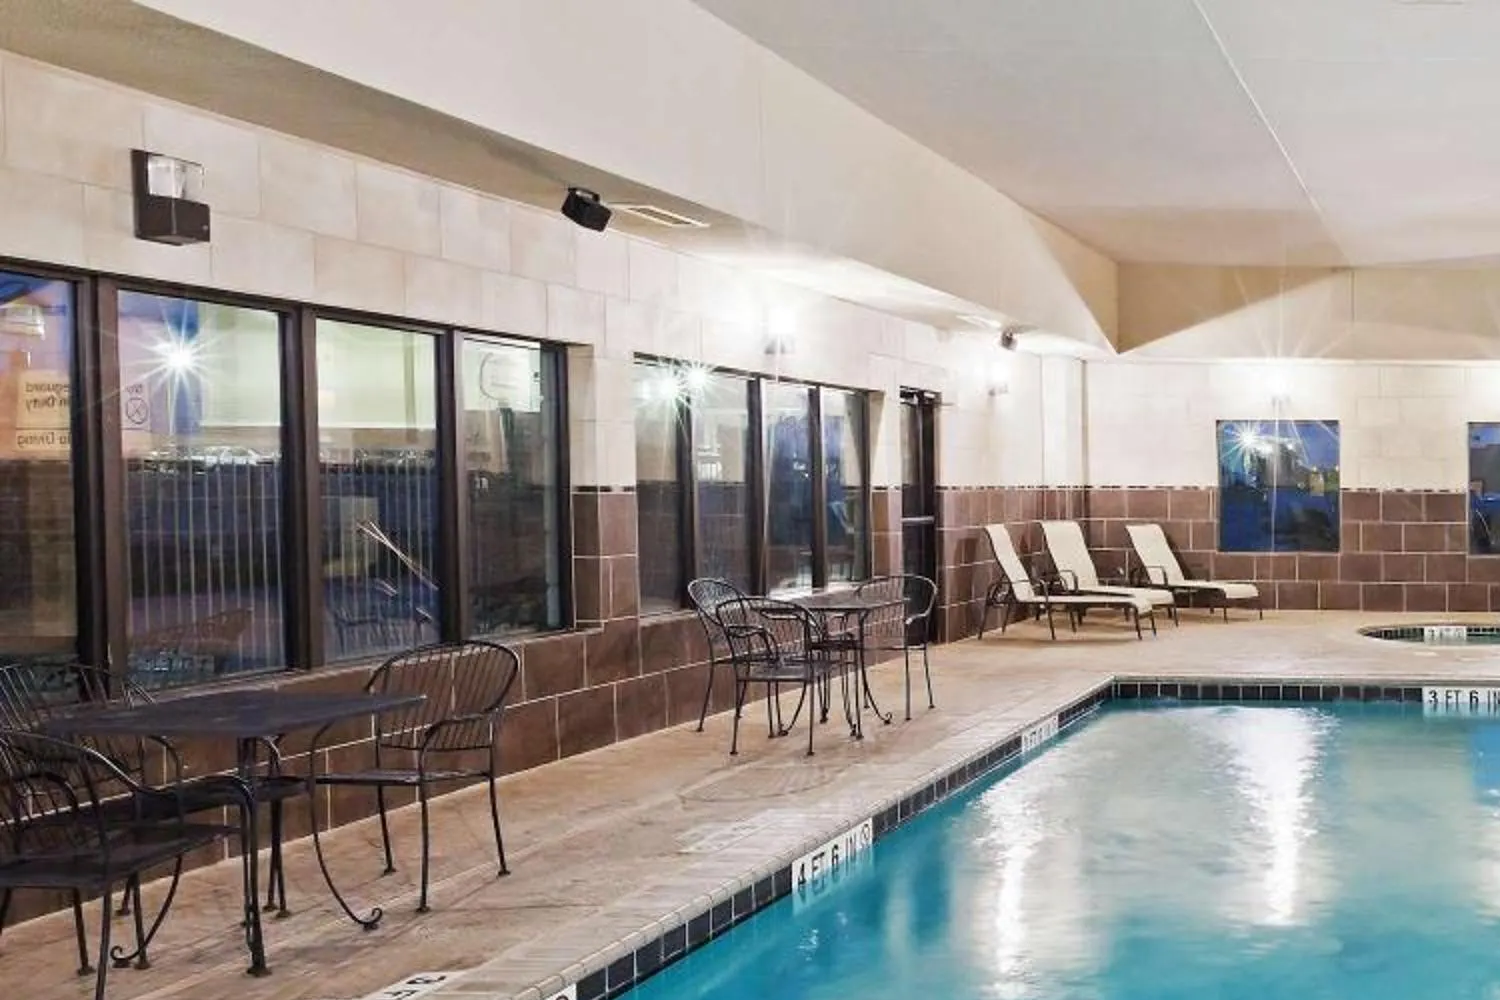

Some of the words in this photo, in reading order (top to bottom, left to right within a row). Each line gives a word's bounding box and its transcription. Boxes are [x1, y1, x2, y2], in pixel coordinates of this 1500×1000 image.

[1428, 690, 1438, 703] 3
[1445, 689, 1461, 704] FT
[1468, 690, 1479, 703] 6
[1487, 690, 1500, 704] IN
